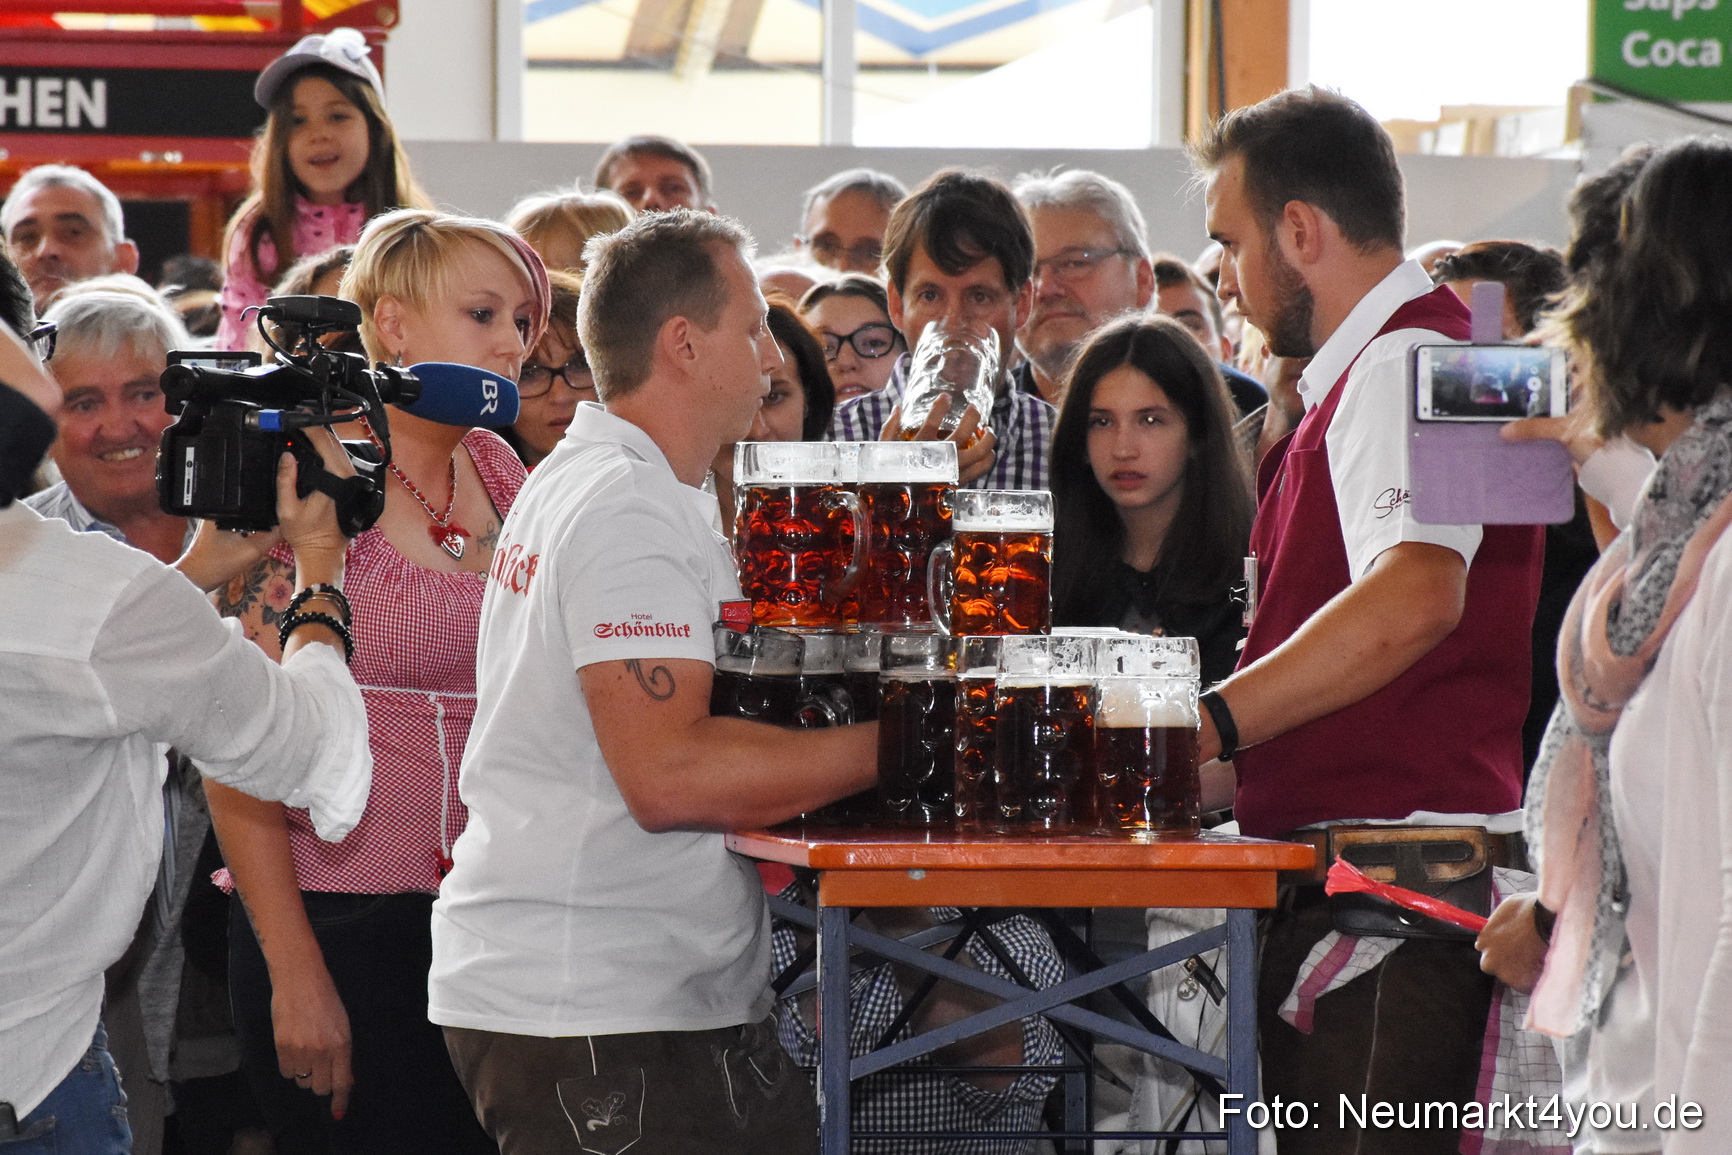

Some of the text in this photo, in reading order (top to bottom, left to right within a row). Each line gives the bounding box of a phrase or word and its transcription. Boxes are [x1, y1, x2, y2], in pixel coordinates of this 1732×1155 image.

[1622, 31, 1722, 68] Coca
[480, 379, 498, 416] BR
[593, 621, 692, 640] Schönblick
[631, 613, 653, 621] Hotel
